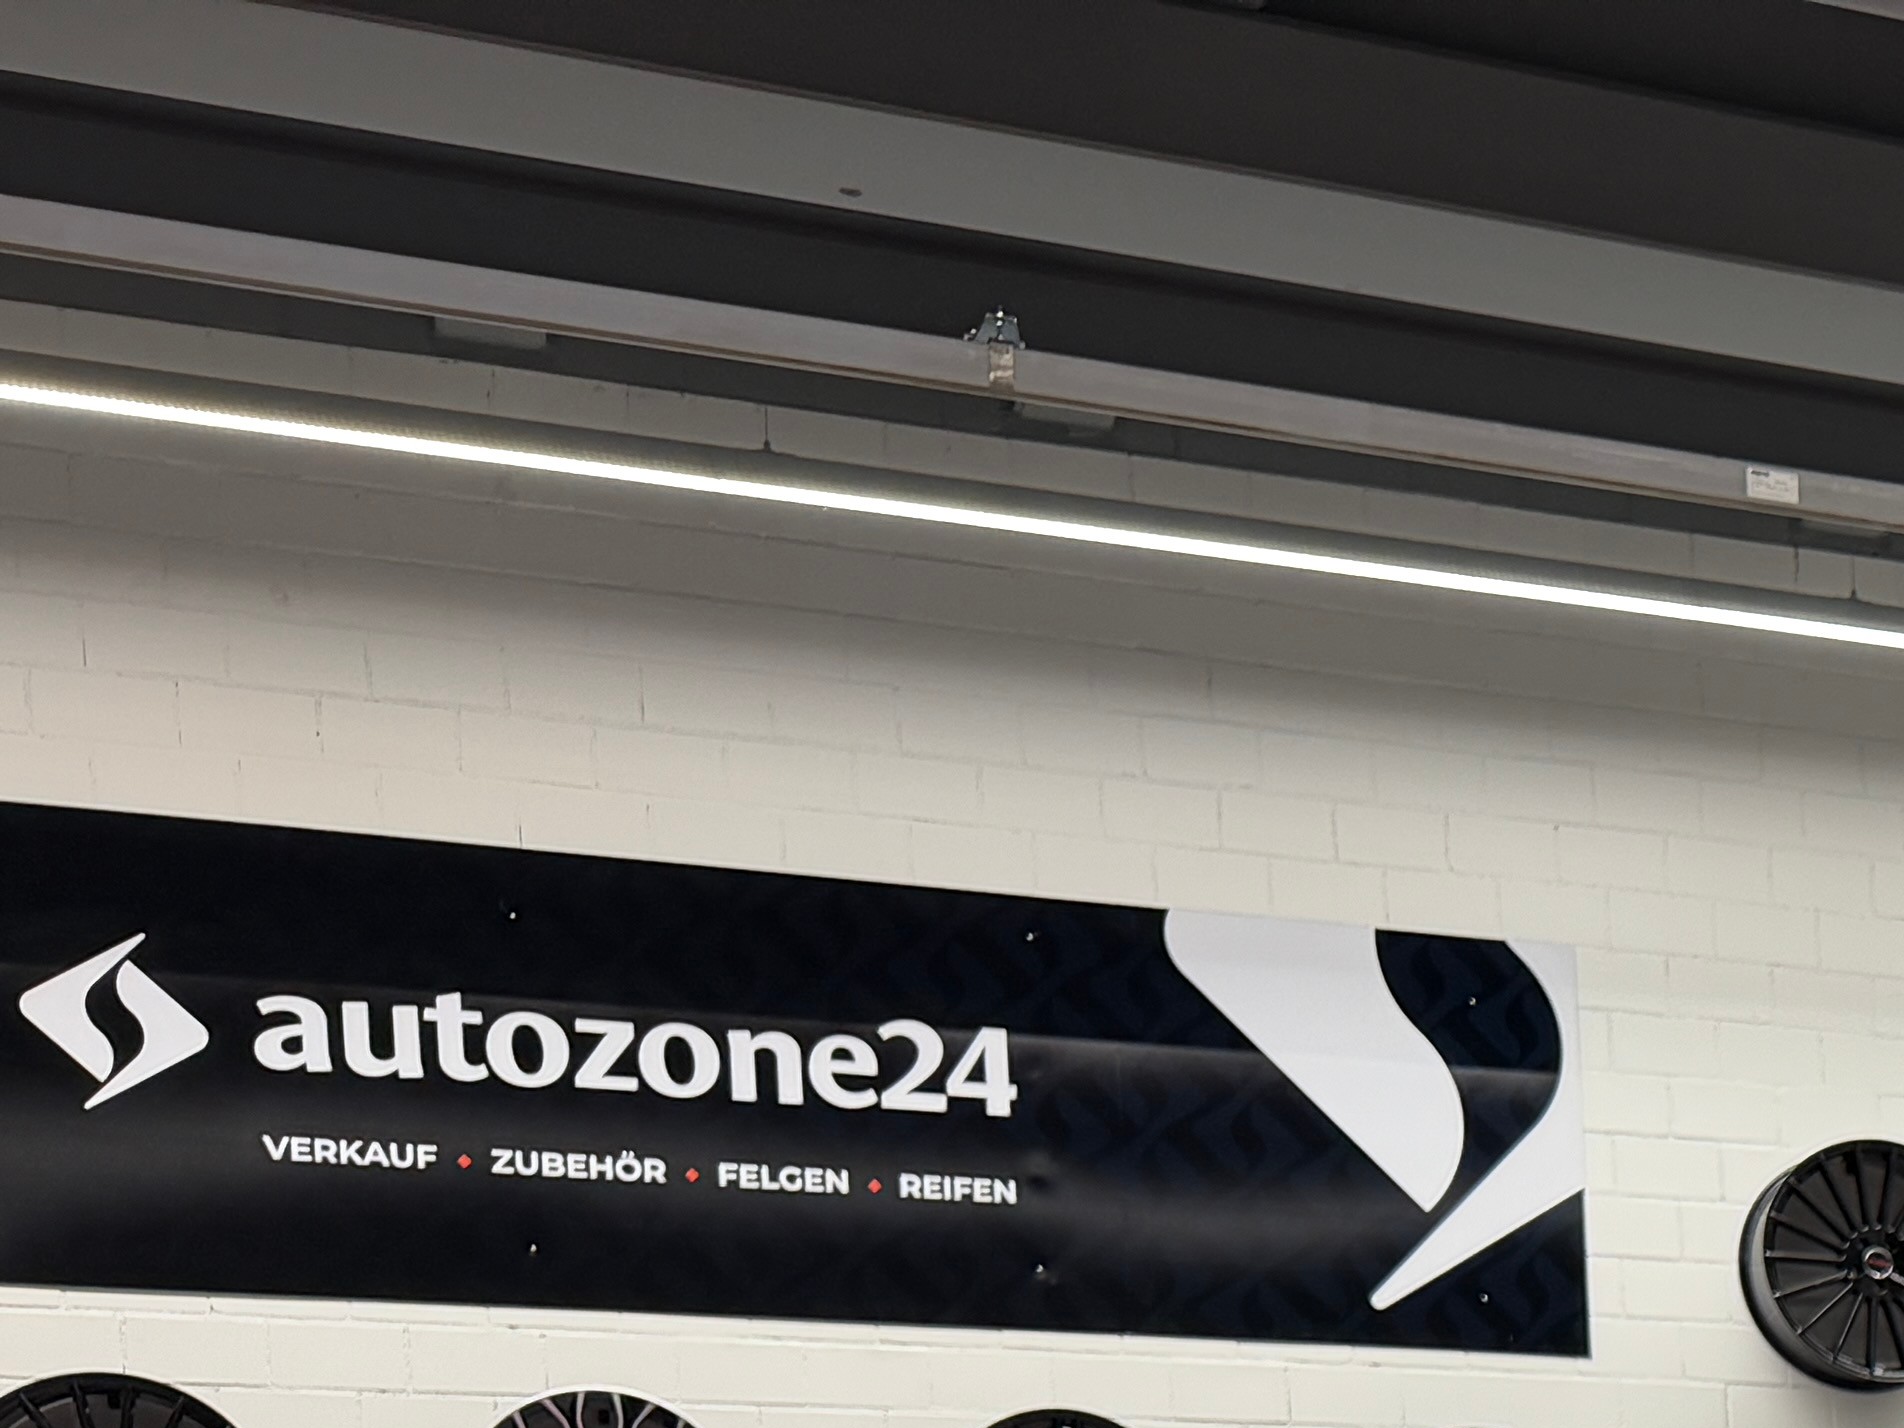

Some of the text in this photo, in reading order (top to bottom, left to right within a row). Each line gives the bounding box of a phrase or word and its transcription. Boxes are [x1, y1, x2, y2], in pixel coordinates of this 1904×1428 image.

[252, 990, 1019, 1119] autozone24
[261, 1133, 1018, 1206] VERKAUF ZUBEHÖR FELGEN REIFEN
